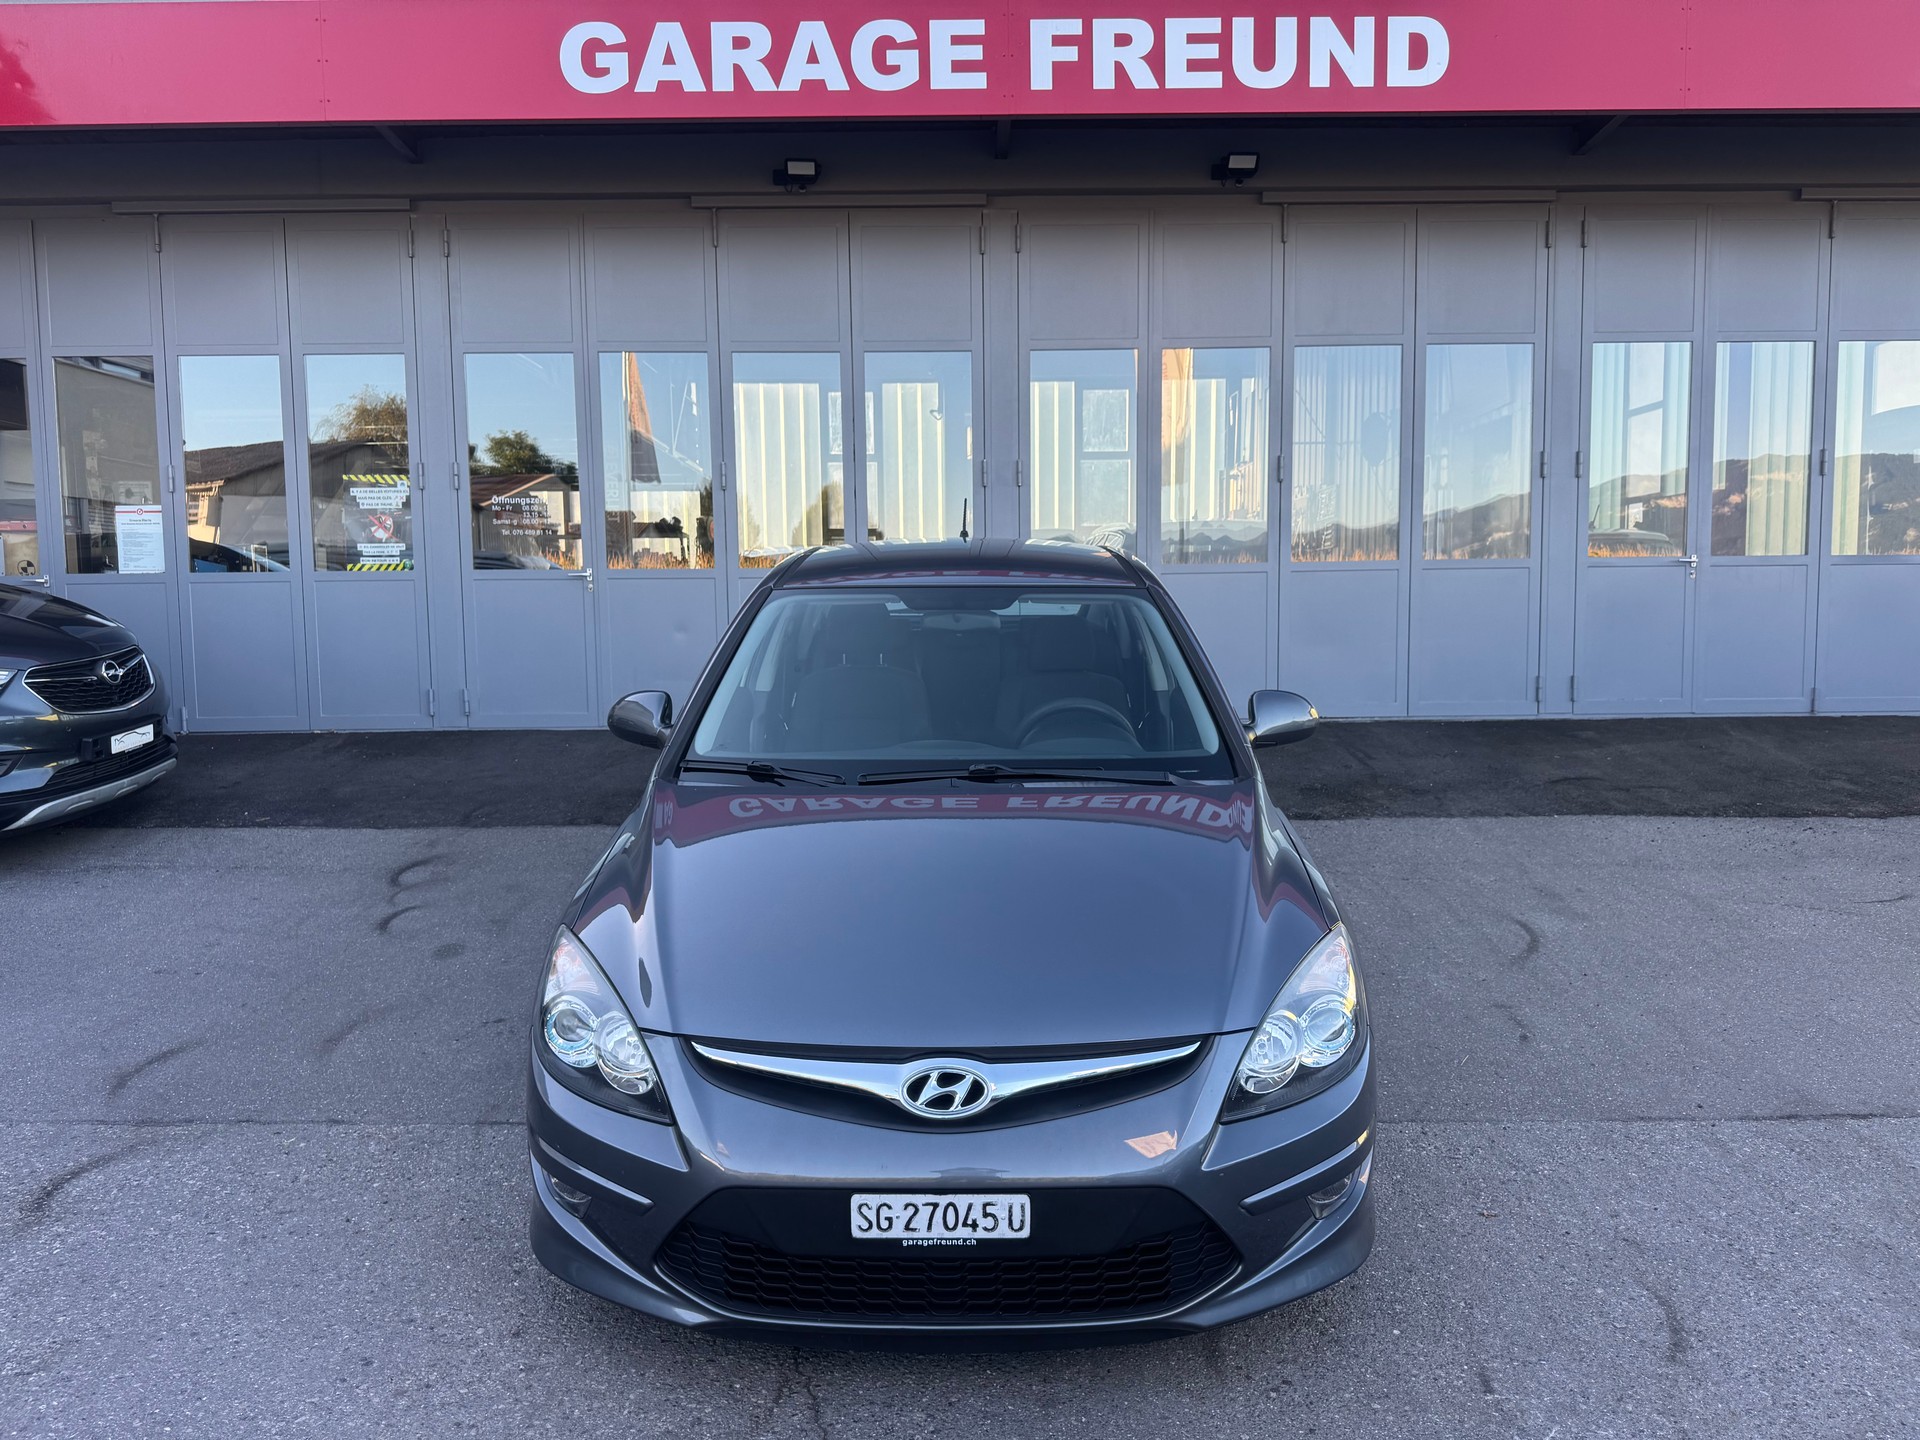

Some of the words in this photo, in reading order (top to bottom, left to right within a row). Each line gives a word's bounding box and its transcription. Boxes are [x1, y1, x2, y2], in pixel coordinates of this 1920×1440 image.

[559, 20, 988, 94] GARAGE
[1029, 16, 1450, 90] FREUND
[902, 1238, 977, 1247] garagefreund.ch
